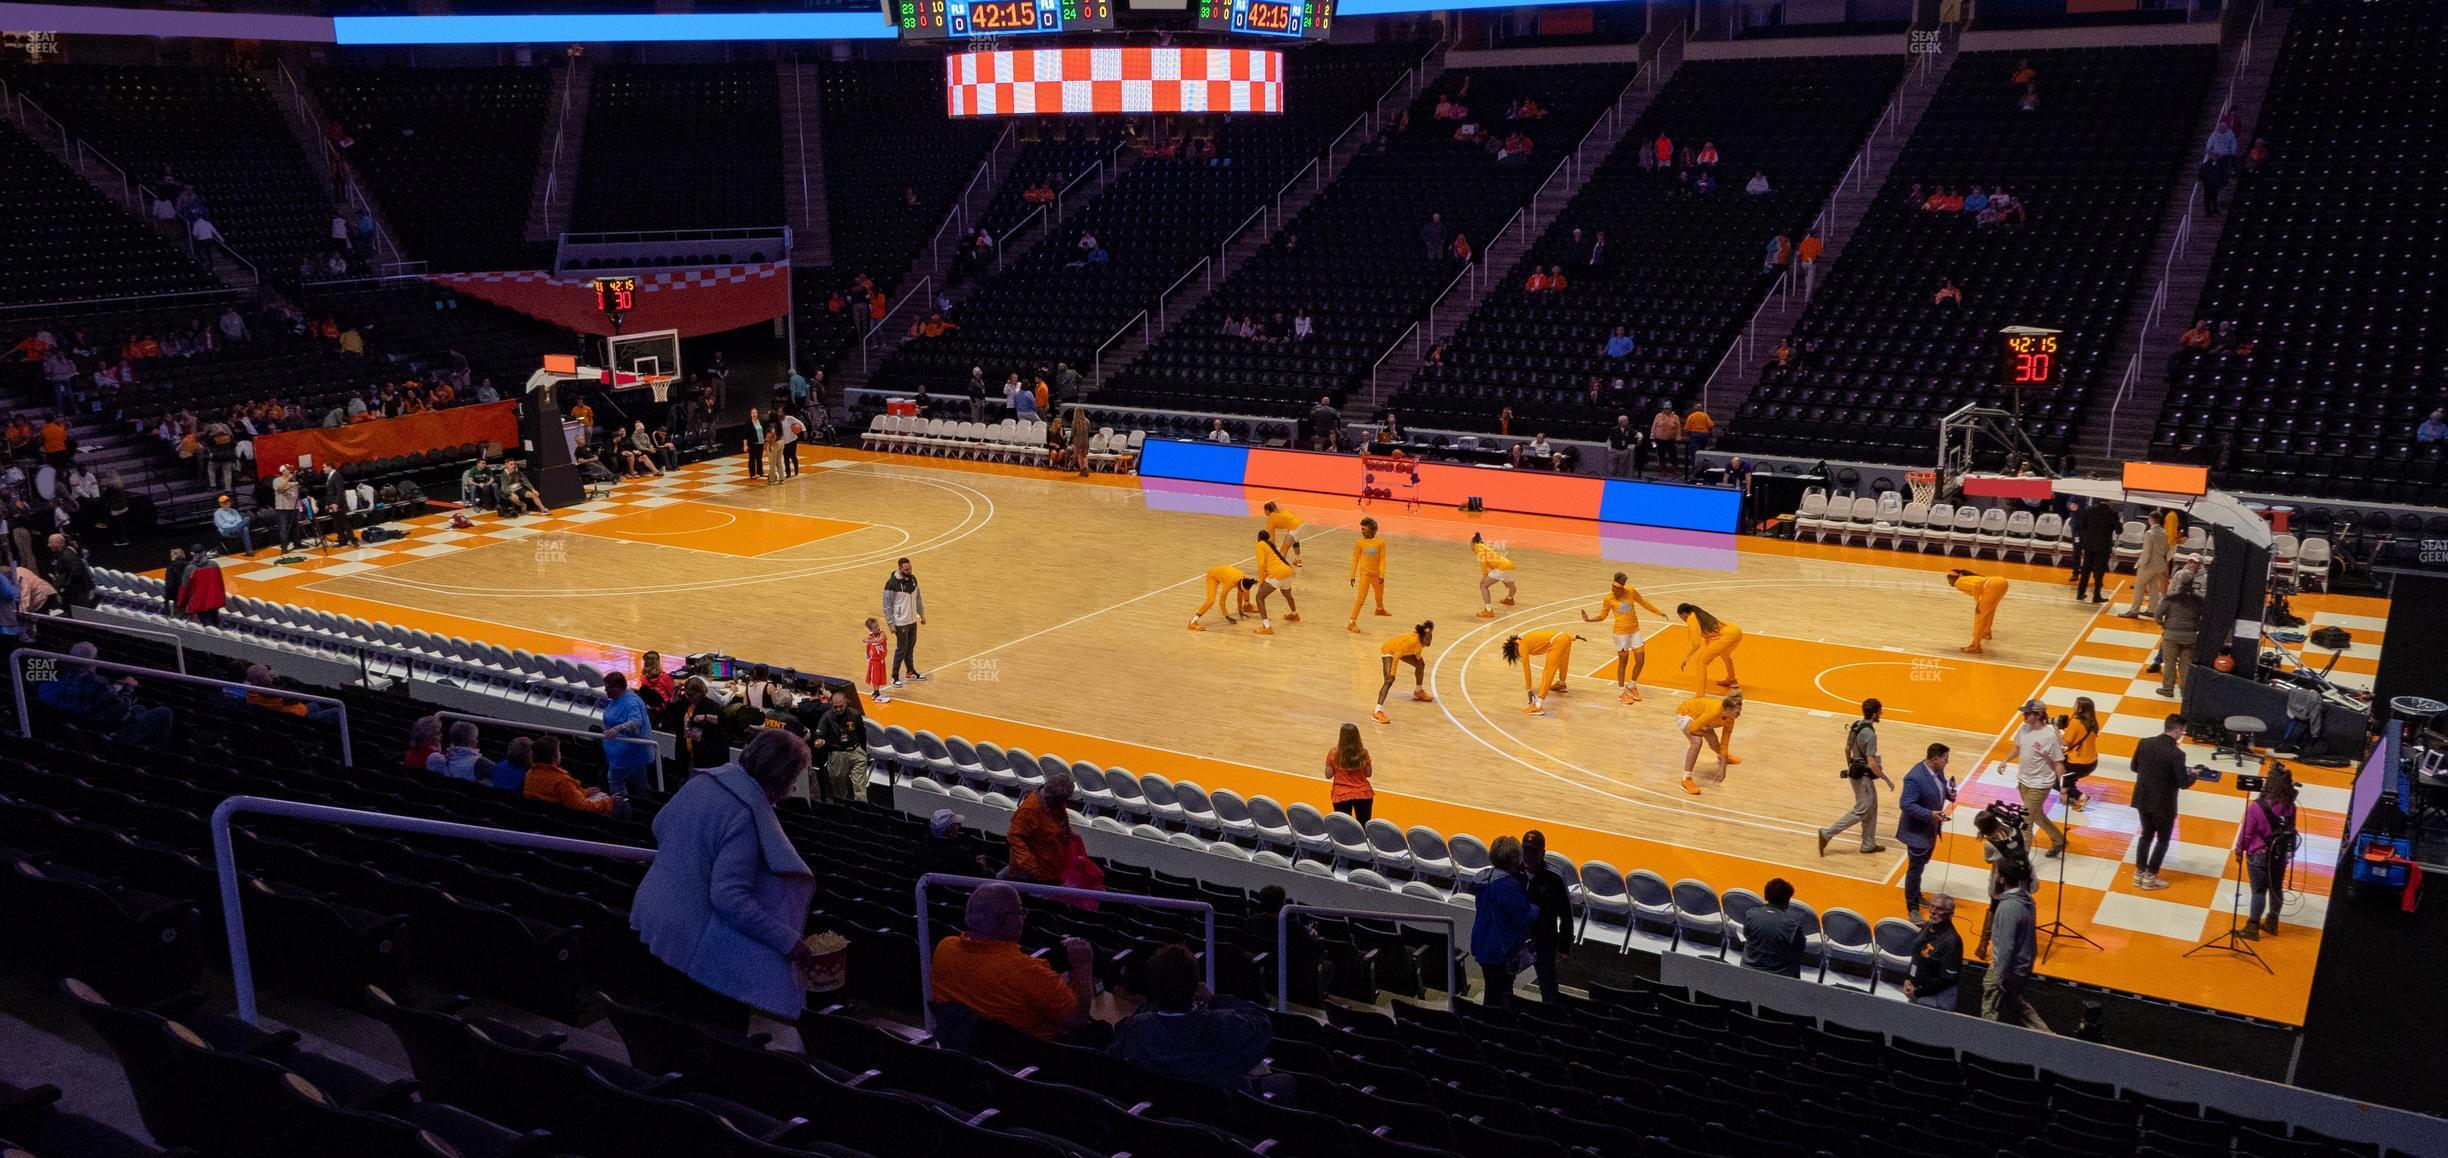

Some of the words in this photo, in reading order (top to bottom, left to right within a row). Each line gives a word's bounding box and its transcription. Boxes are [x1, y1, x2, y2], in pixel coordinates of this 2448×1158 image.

[902, 3, 915, 14] 23
[920, 2, 924, 12] 1
[932, 1, 944, 12] 10
[1064, 8, 1076, 20] 24
[1084, 6, 1092, 18] 0
[1099, 6, 1107, 18] 0
[1200, 6, 1210, 18] 33
[1213, 7, 1218, 18] 0
[1224, 8, 1230, 20] 0
[1304, 4, 1312, 14] 21
[904, 17, 916, 28] 33
[920, 16, 927, 26] 0
[936, 15, 942, 26] 0
[972, 2, 1035, 28] 42:15
[1044, 13, 1052, 26] 0
[1236, 14, 1243, 26] 0
[1248, 3, 1288, 28] 42:15
[955, 18, 964, 30] 0
[1292, 18, 1298, 31] 0
[1304, 17, 1312, 28] 24
[1323, 18, 1328, 29] 0
[615, 291, 632, 310] 30
[2010, 336, 2057, 352] 42:15
[2016, 354, 2049, 382] 30
